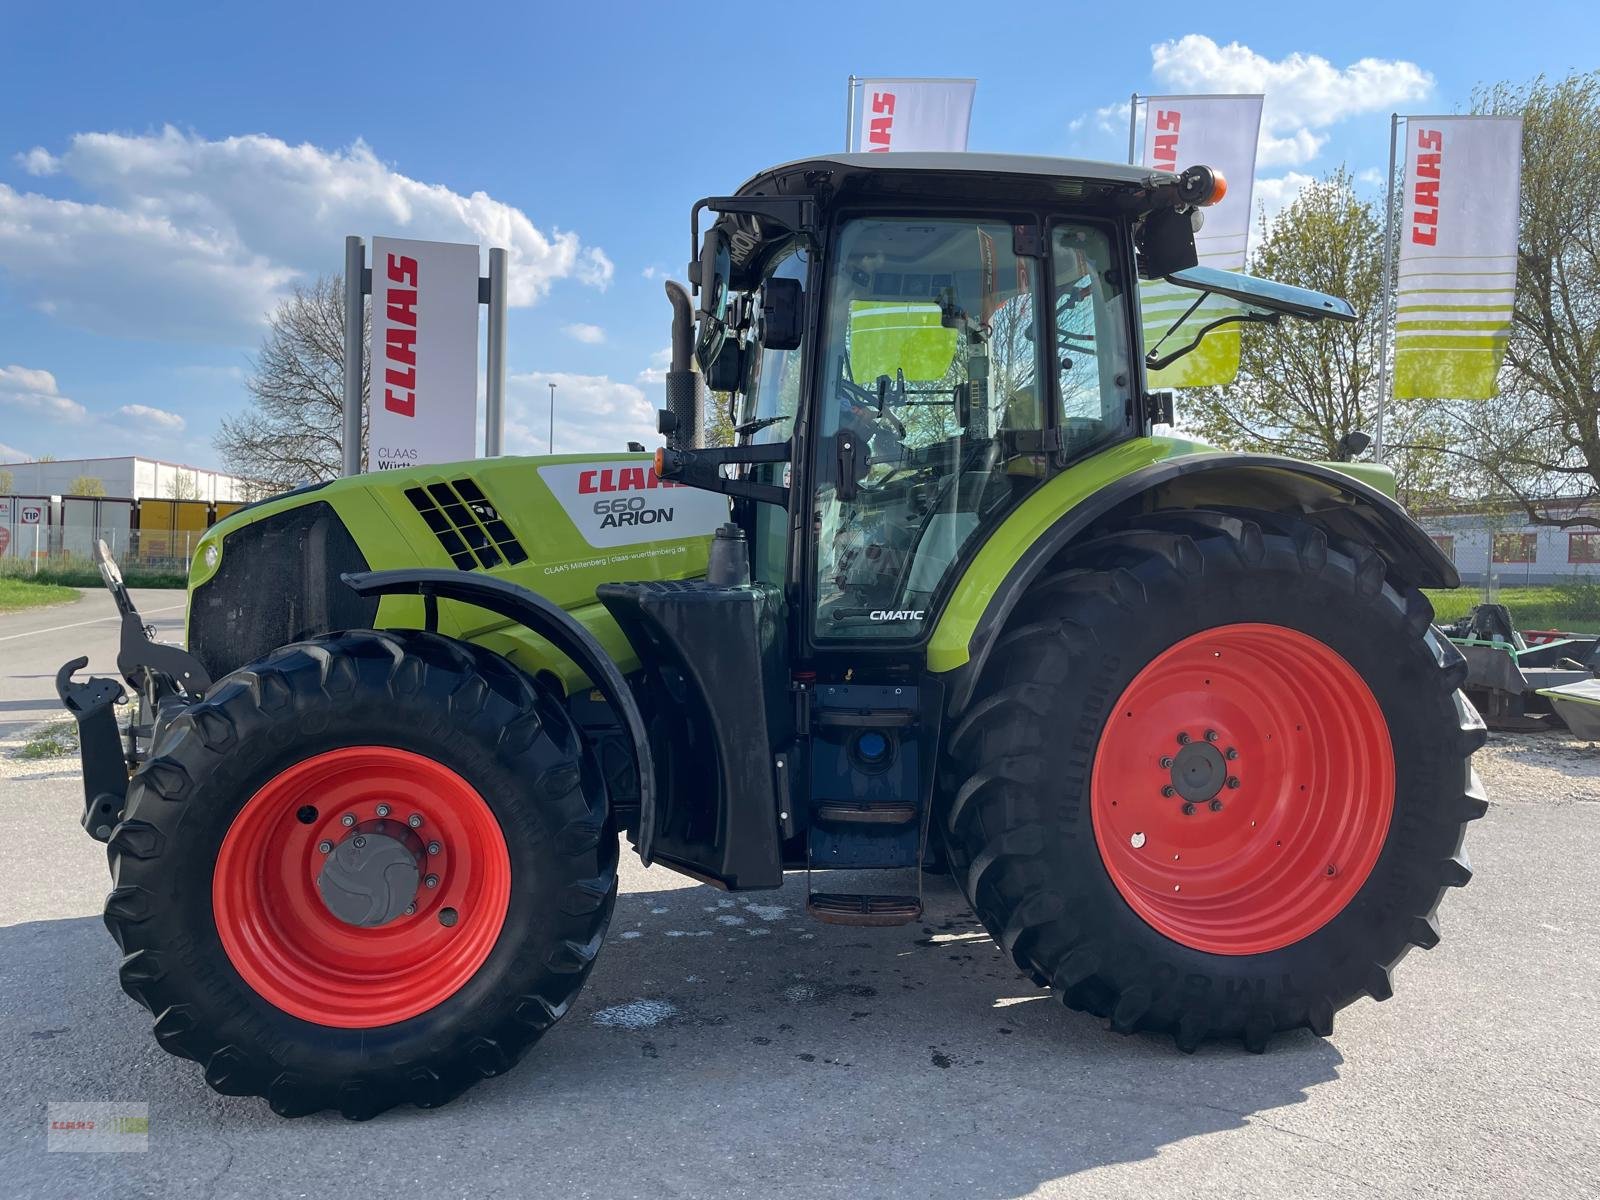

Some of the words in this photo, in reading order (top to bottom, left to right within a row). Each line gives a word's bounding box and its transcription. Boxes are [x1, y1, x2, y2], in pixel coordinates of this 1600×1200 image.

[869, 93, 896, 152] AS
[1412, 129, 1442, 246] CLAAS
[385, 253, 418, 418] CLAAS
[378, 447, 418, 459] CLAAS
[593, 496, 645, 515] 660
[24, 512, 38, 520] TIP
[600, 508, 673, 529] ARION
[543, 565, 569, 575] CLAAS
[869, 610, 925, 620] CMATIC
